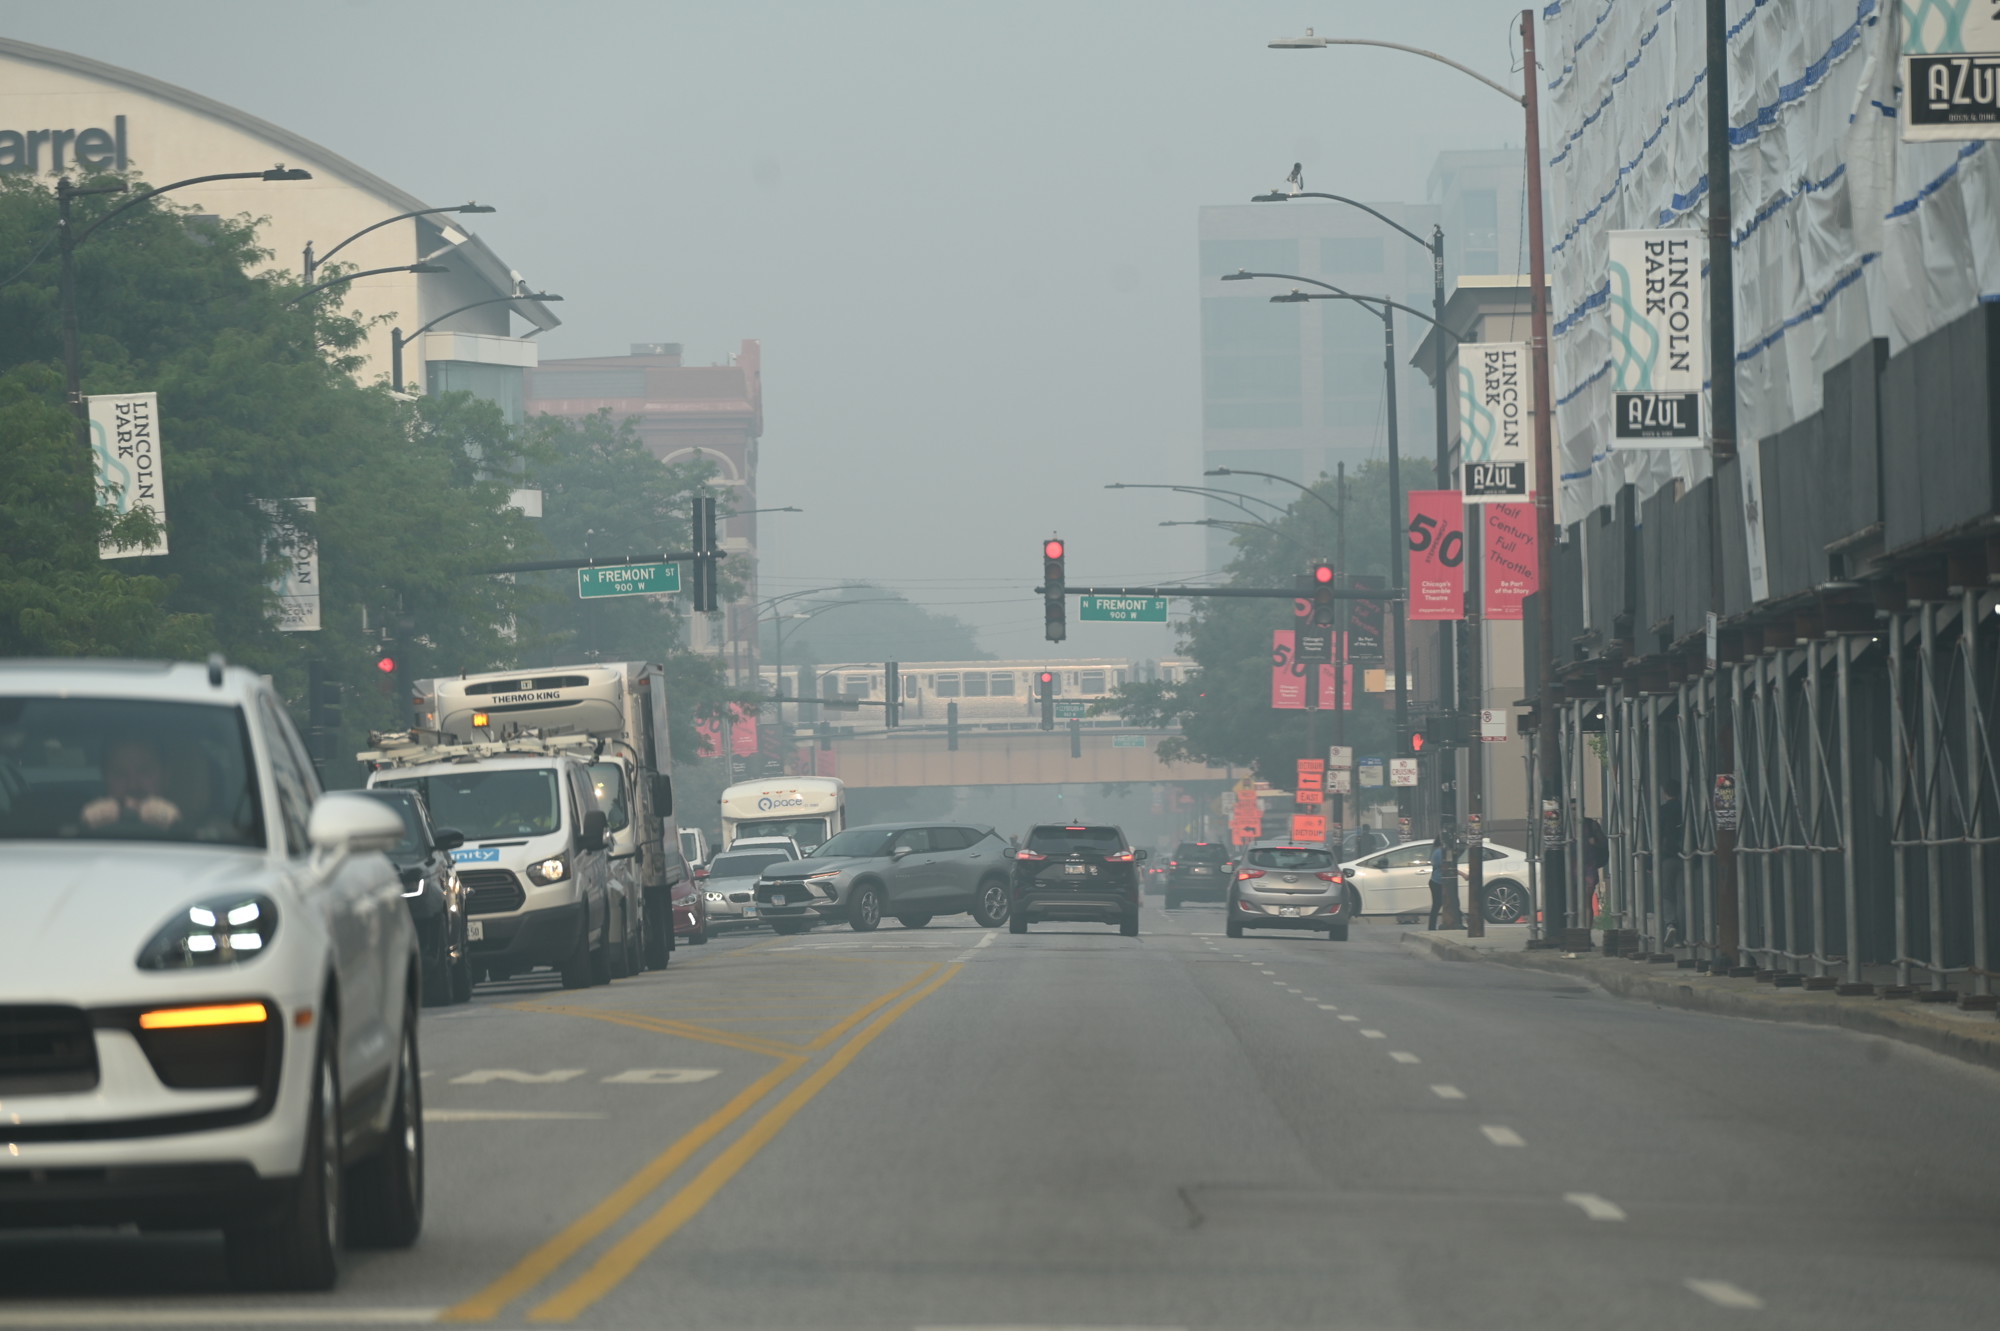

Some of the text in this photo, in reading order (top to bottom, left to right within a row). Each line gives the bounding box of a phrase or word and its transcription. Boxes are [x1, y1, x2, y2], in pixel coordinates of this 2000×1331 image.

[1645, 241, 1665, 316] PARK
[1668, 240, 1689, 372] LINCOLN
[1485, 352, 1500, 406] PARK
[1502, 351, 1519, 447] LINCOLN
[1629, 394, 1686, 430] AZUL
[115, 403, 133, 459] PARK
[133, 402, 154, 498] LINCOLN
[1474, 463, 1516, 489] AZUL
[1496, 503, 1520, 519] Half
[1489, 516, 1533, 544] Century.
[1496, 536, 1517, 552] Full
[583, 568, 675, 582] N FREMONT ST
[1489, 551, 1533, 579] Throttle.
[615, 582, 646, 591] 900 W
[1096, 600, 1147, 610] FREMONT
[492, 691, 560, 704] THERMO KING
[1400, 760, 1408, 768] NO
[774, 799, 802, 808] pace
[1301, 792, 1318, 801] EAST
